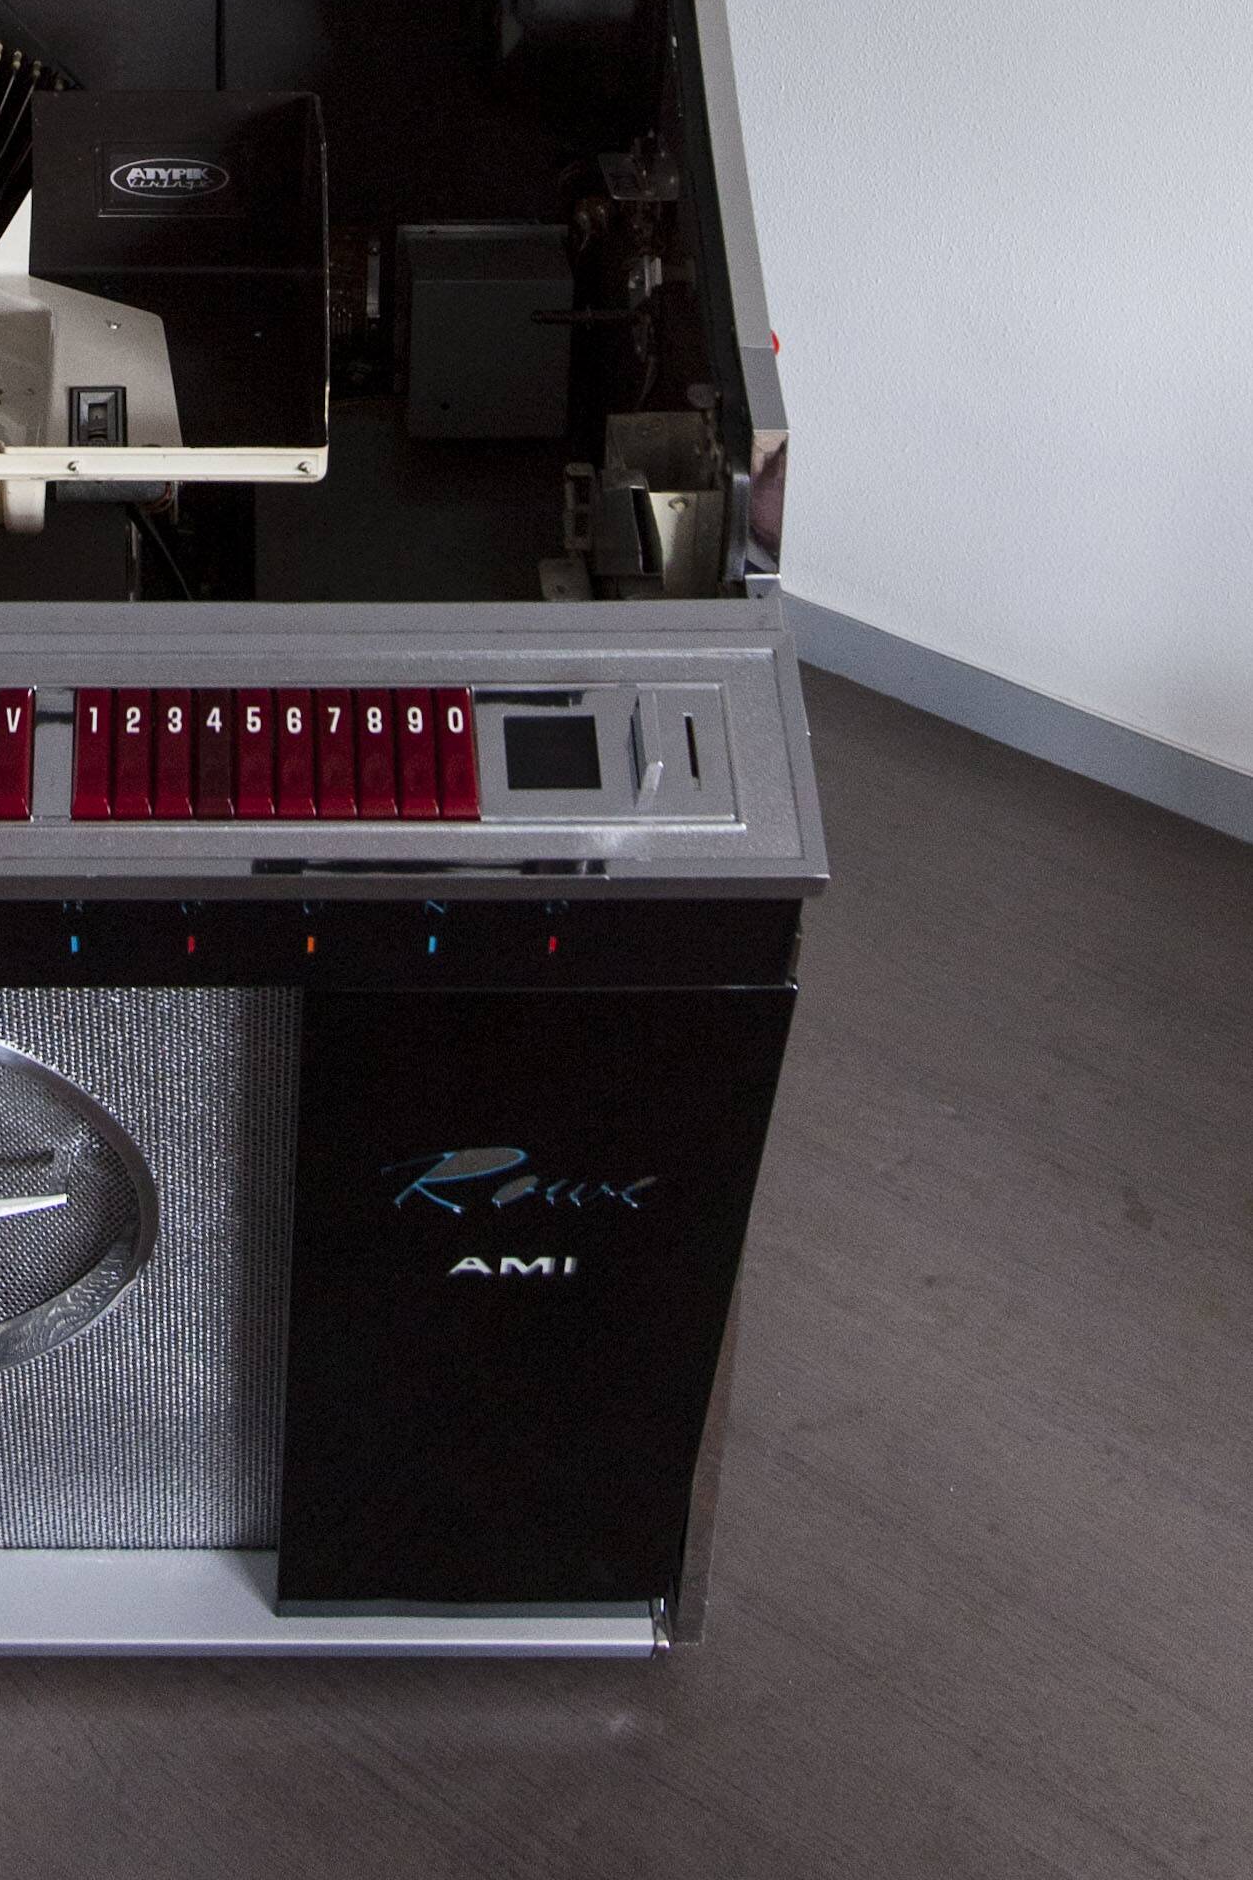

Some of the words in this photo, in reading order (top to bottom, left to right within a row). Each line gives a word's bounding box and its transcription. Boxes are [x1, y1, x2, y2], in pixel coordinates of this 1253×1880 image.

[6, 707, 21, 733] V
[89, 707, 98, 733] 1
[126, 706, 141, 733] 2
[167, 706, 183, 733] 3
[206, 707, 223, 733] 4
[246, 706, 262, 733] 5
[286, 707, 302, 734] 6
[327, 707, 341, 733] 7
[366, 706, 383, 734] 8
[407, 706, 423, 733] 9
[447, 706, 464, 733] 0
[449, 1256, 578, 1277] AMI
